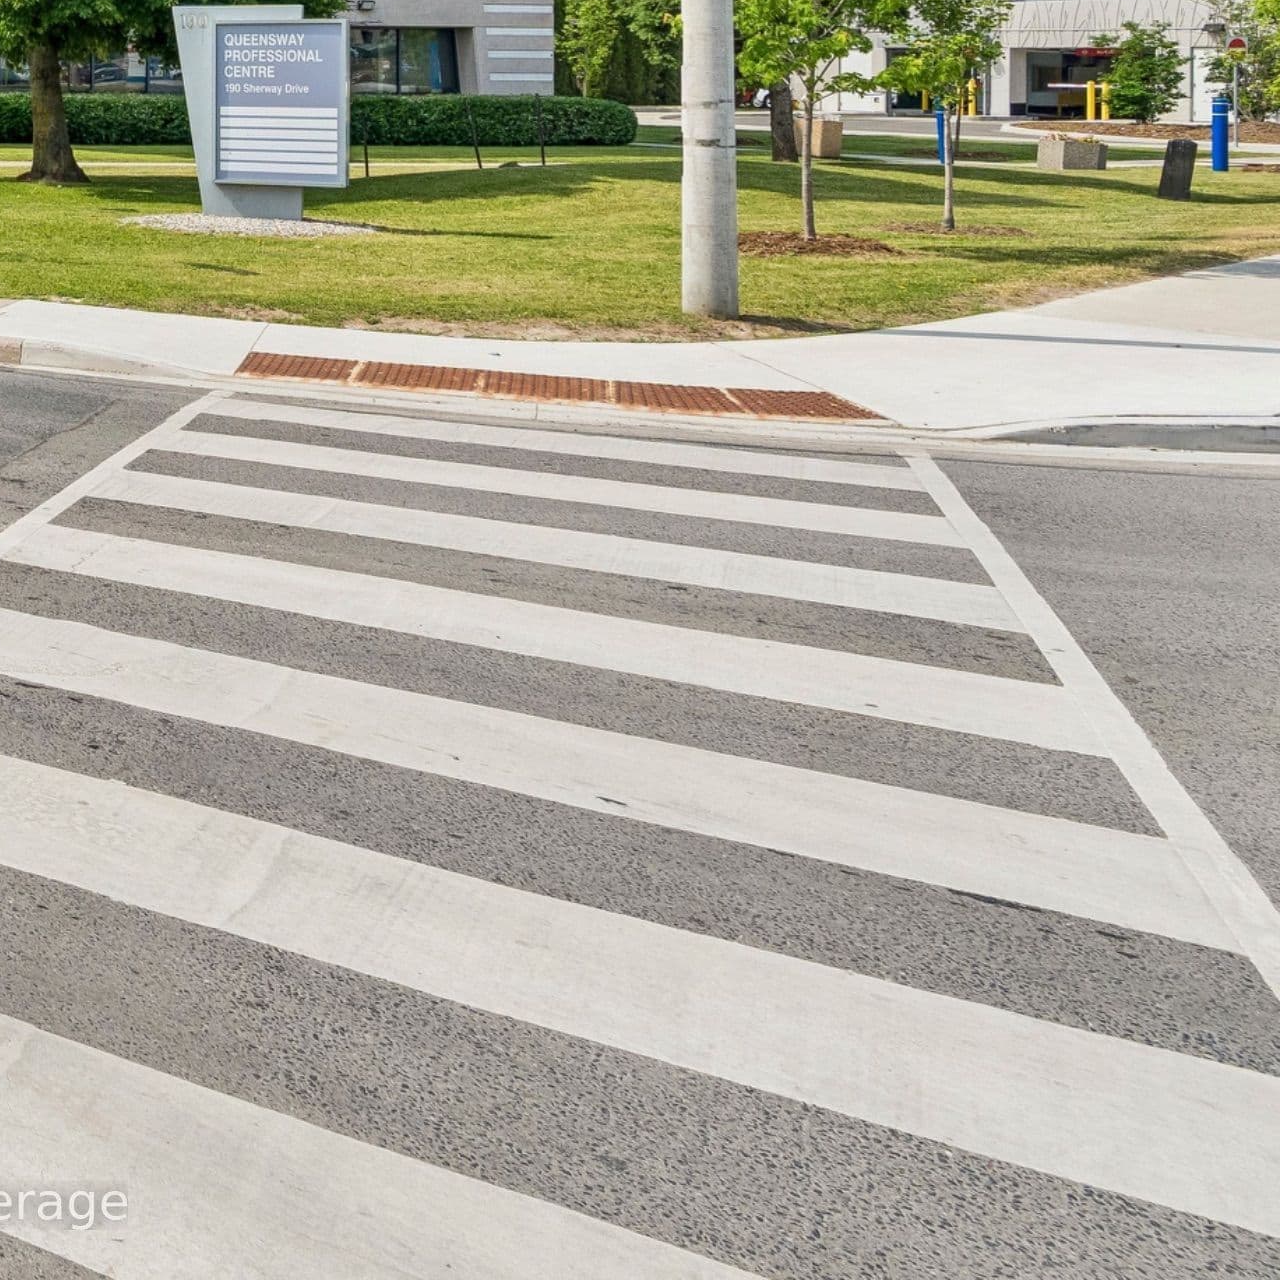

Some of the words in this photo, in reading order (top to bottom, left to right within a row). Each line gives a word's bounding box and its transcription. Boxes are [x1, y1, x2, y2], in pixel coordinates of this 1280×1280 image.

[224, 33, 305, 47] QUEENSWAY
[224, 49, 323, 62] PROFESSIONAL
[224, 65, 275, 78] CENTRE
[225, 83, 240, 92] 190
[242, 83, 282, 95] Sherway
[285, 83, 309, 93] Drive
